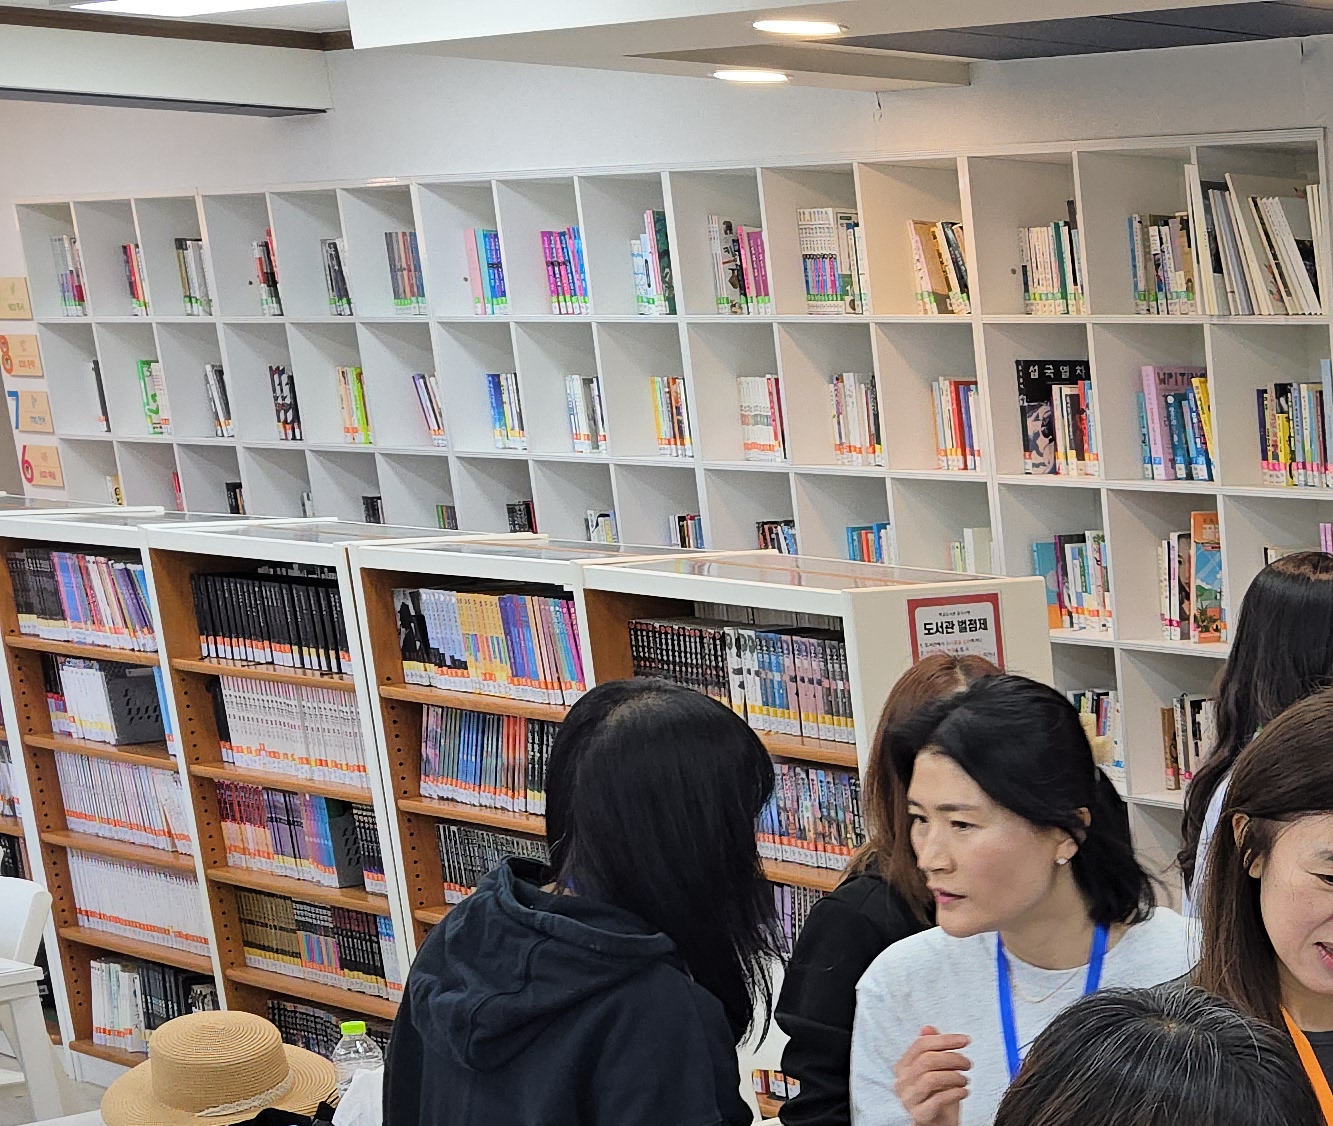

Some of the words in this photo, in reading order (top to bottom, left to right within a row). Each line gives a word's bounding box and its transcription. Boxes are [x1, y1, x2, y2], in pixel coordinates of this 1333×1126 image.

[7, 391, 19, 429] 7
[22, 445, 34, 483] 6
[924, 620, 955, 635] 도서관
[957, 618, 988, 633] 벌점제
